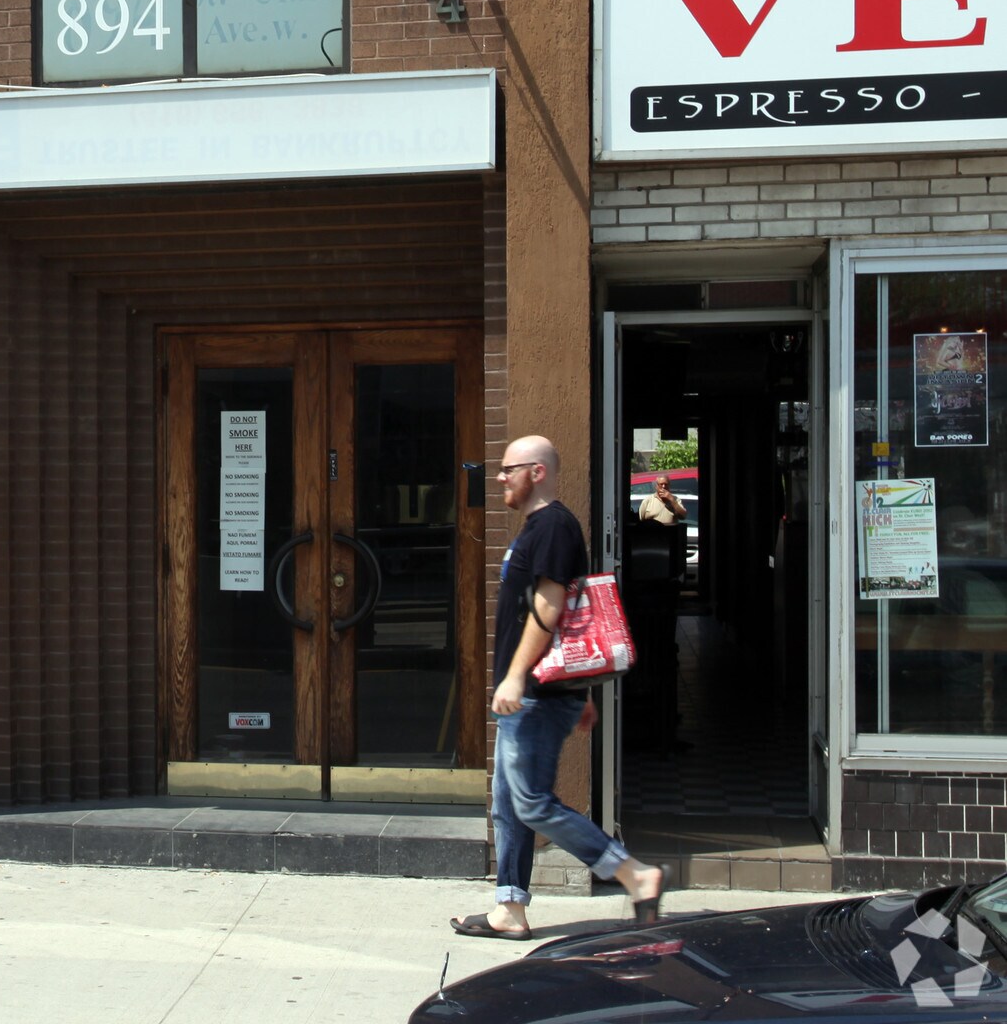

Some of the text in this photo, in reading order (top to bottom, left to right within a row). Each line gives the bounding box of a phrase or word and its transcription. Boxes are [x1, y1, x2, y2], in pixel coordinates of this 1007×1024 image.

[646, 84, 926, 124] ESPRESSO
[230, 416, 257, 424] DO NOT
[229, 429, 258, 438] SMOKE
[235, 444, 252, 452] HERE
[235, 718, 264, 726] VOXCOM
